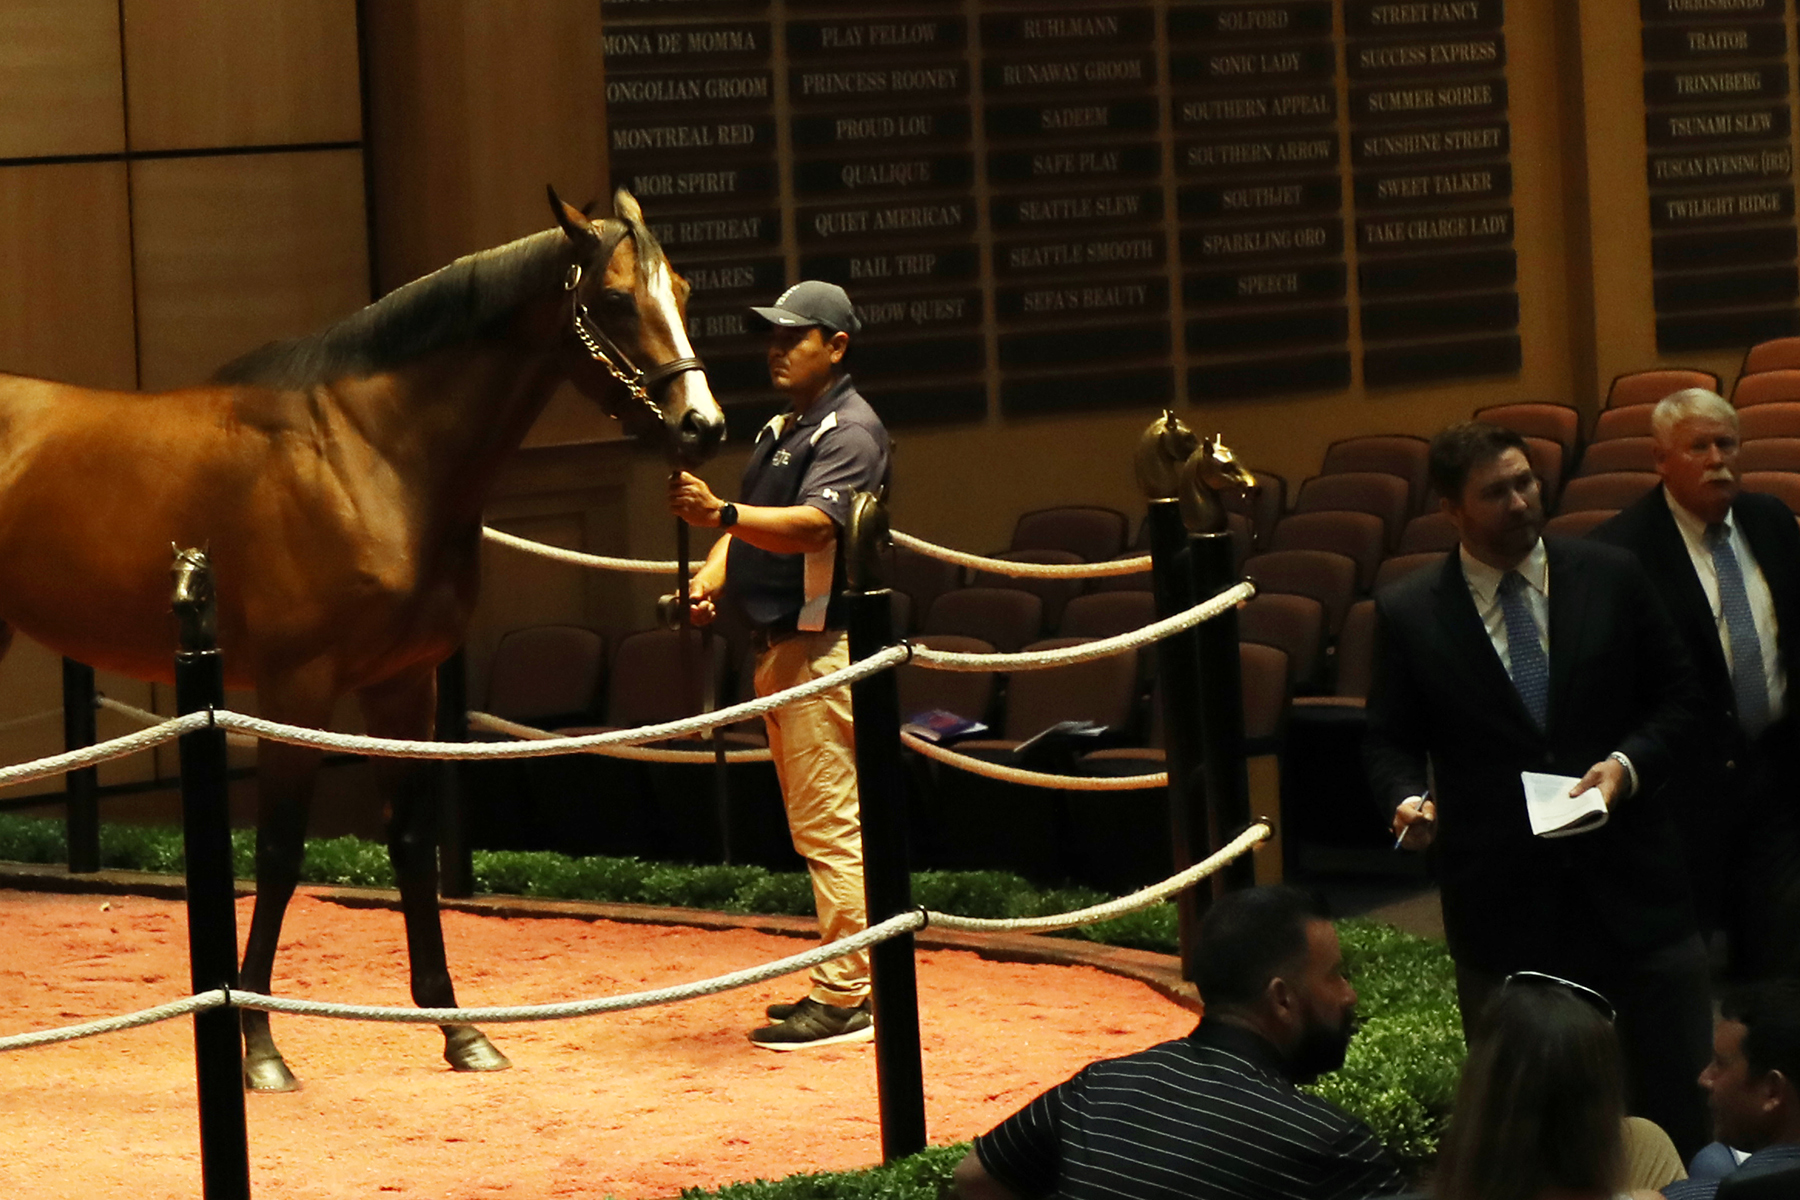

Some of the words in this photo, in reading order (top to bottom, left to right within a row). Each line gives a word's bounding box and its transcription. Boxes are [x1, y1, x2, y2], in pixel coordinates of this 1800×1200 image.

[1218, 9, 1288, 30] SOLFORD
[1372, 4, 1429, 25] STREET
[1433, 2, 1479, 22] FANCY
[602, 34, 652, 56] MONA
[658, 32, 682, 52] DE
[687, 30, 756, 52] MOMMA
[821, 26, 864, 48] PLAY
[869, 23, 937, 45] FELLOW
[1688, 31, 1748, 51] TRAITOR
[1210, 56, 1255, 77] SONIC
[1260, 53, 1300, 74] LADY
[1361, 47, 1426, 68] SUCCESS
[1430, 42, 1496, 63] EXPRESS
[802, 72, 886, 95] PRINCESS
[892, 69, 959, 91] ROONEY
[1003, 62, 1080, 85] RUNAWAY
[1084, 60, 1141, 81] GROOM
[606, 80, 700, 102] ONGOLIAN
[705, 77, 768, 98] GROOM
[1369, 90, 1434, 111] SUMMER
[1438, 85, 1492, 107] SOIREE
[613, 126, 712, 150] MONTREAL
[718, 124, 754, 145] RED
[835, 118, 894, 140] PROUD
[899, 116, 932, 136] LOU
[1669, 115, 1732, 137] TSUNAMI
[1735, 112, 1772, 132] SLEW
[1188, 143, 1272, 166] SOUTHERN
[1276, 140, 1331, 160] ARROW
[1364, 133, 1441, 156] SUNSHINE
[1445, 128, 1501, 149] STREET
[1033, 153, 1074, 174] SAFE
[1080, 151, 1121, 172] PLAY
[635, 174, 673, 196] MOR
[678, 171, 736, 193] SPIRIT
[1378, 177, 1430, 198] SWEET
[1433, 172, 1491, 194] TALKER
[1019, 198, 1091, 220] SEATTLE
[1095, 196, 1140, 217] SLEW
[682, 217, 761, 242] RETREAT
[815, 211, 868, 237] QUIET
[873, 205, 962, 230] AMERICAN
[1365, 222, 1404, 242] TAKE
[1408, 217, 1467, 239] CHARGE
[1471, 215, 1508, 235] LADY
[1010, 244, 1082, 268] SEATTLE
[1087, 239, 1153, 262] SMOOTH
[1203, 231, 1292, 255] SPARKLING
[1294, 228, 1326, 248] ORO
[849, 258, 891, 279] RAIL
[896, 255, 937, 275] TRIP
[1083, 285, 1148, 308] BEAUTY
[1238, 273, 1298, 296] SPEECH
[854, 301, 905, 325] NBOW
[910, 298, 964, 322] QUEST
